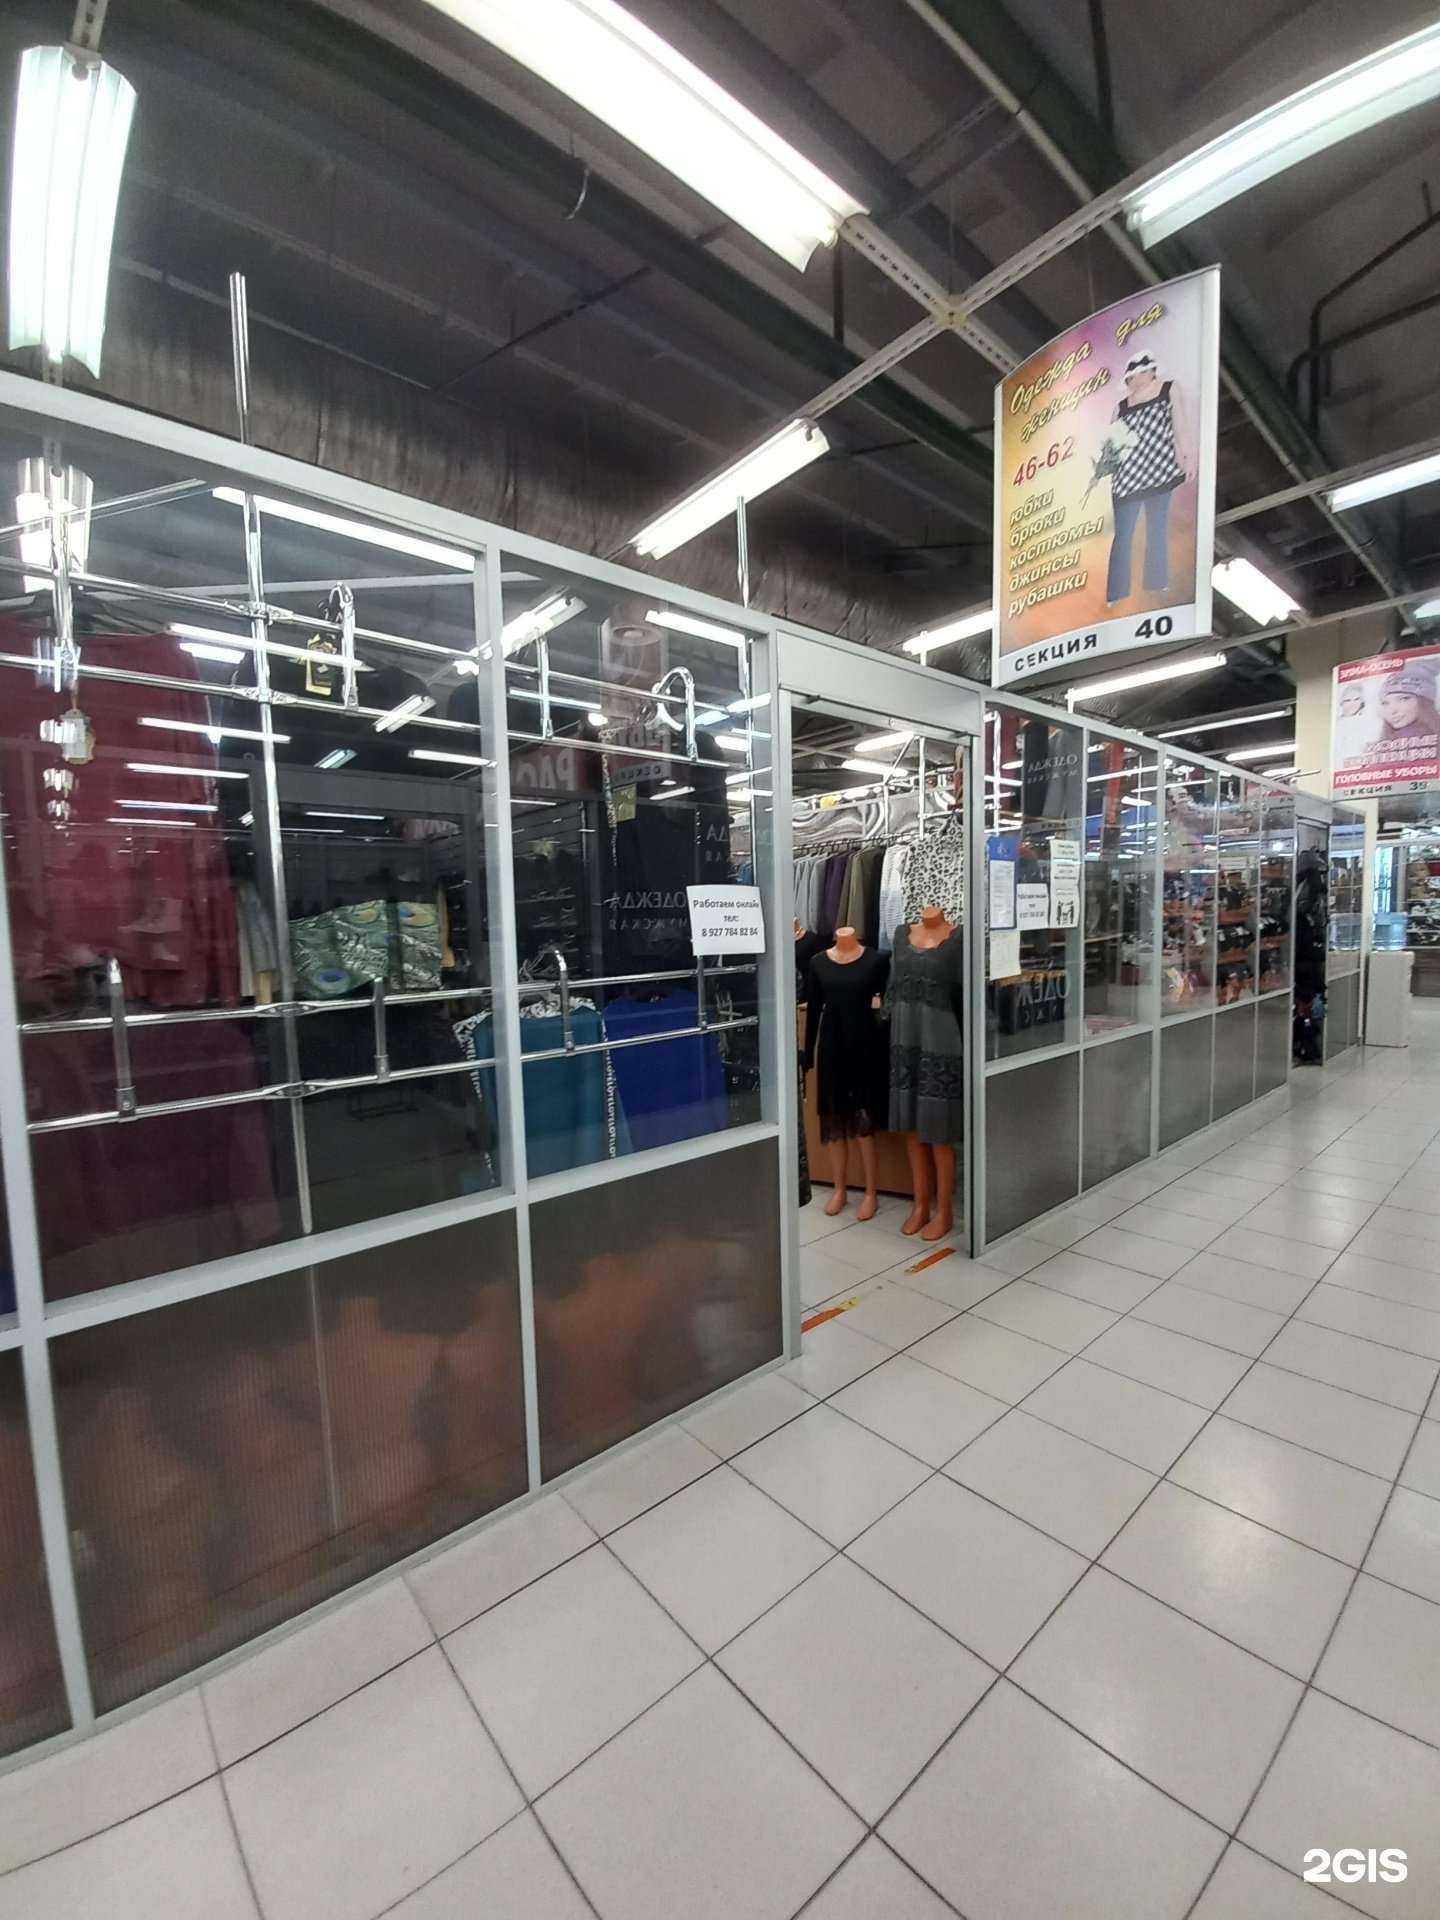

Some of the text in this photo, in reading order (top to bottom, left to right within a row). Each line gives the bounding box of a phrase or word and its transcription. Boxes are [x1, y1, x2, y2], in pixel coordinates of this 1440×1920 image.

[1010, 303, 1164, 415] Одежда для
[1020, 367, 1111, 444] женщин
[1012, 436, 1074, 486] 46-62
[1009, 489, 1054, 527] юбки
[1009, 507, 1065, 549] брюки
[1009, 517, 1104, 570] костюмы
[1009, 549, 1081, 592] джинсы
[1008, 572, 1088, 618] рубашки
[1014, 616, 1173, 672] СЕКЦИЯ 40
[1336, 765, 1438, 785] ГОЛОВНЫЕ УБОРЫ
[1344, 784, 1392, 796] СЕКЦИЯ
[693, 899, 735, 908] Работаем
[702, 928, 708, 937] 8
[709, 928, 723, 937] 927
[724, 928, 738, 937] 784
[740, 928, 748, 936] 82
